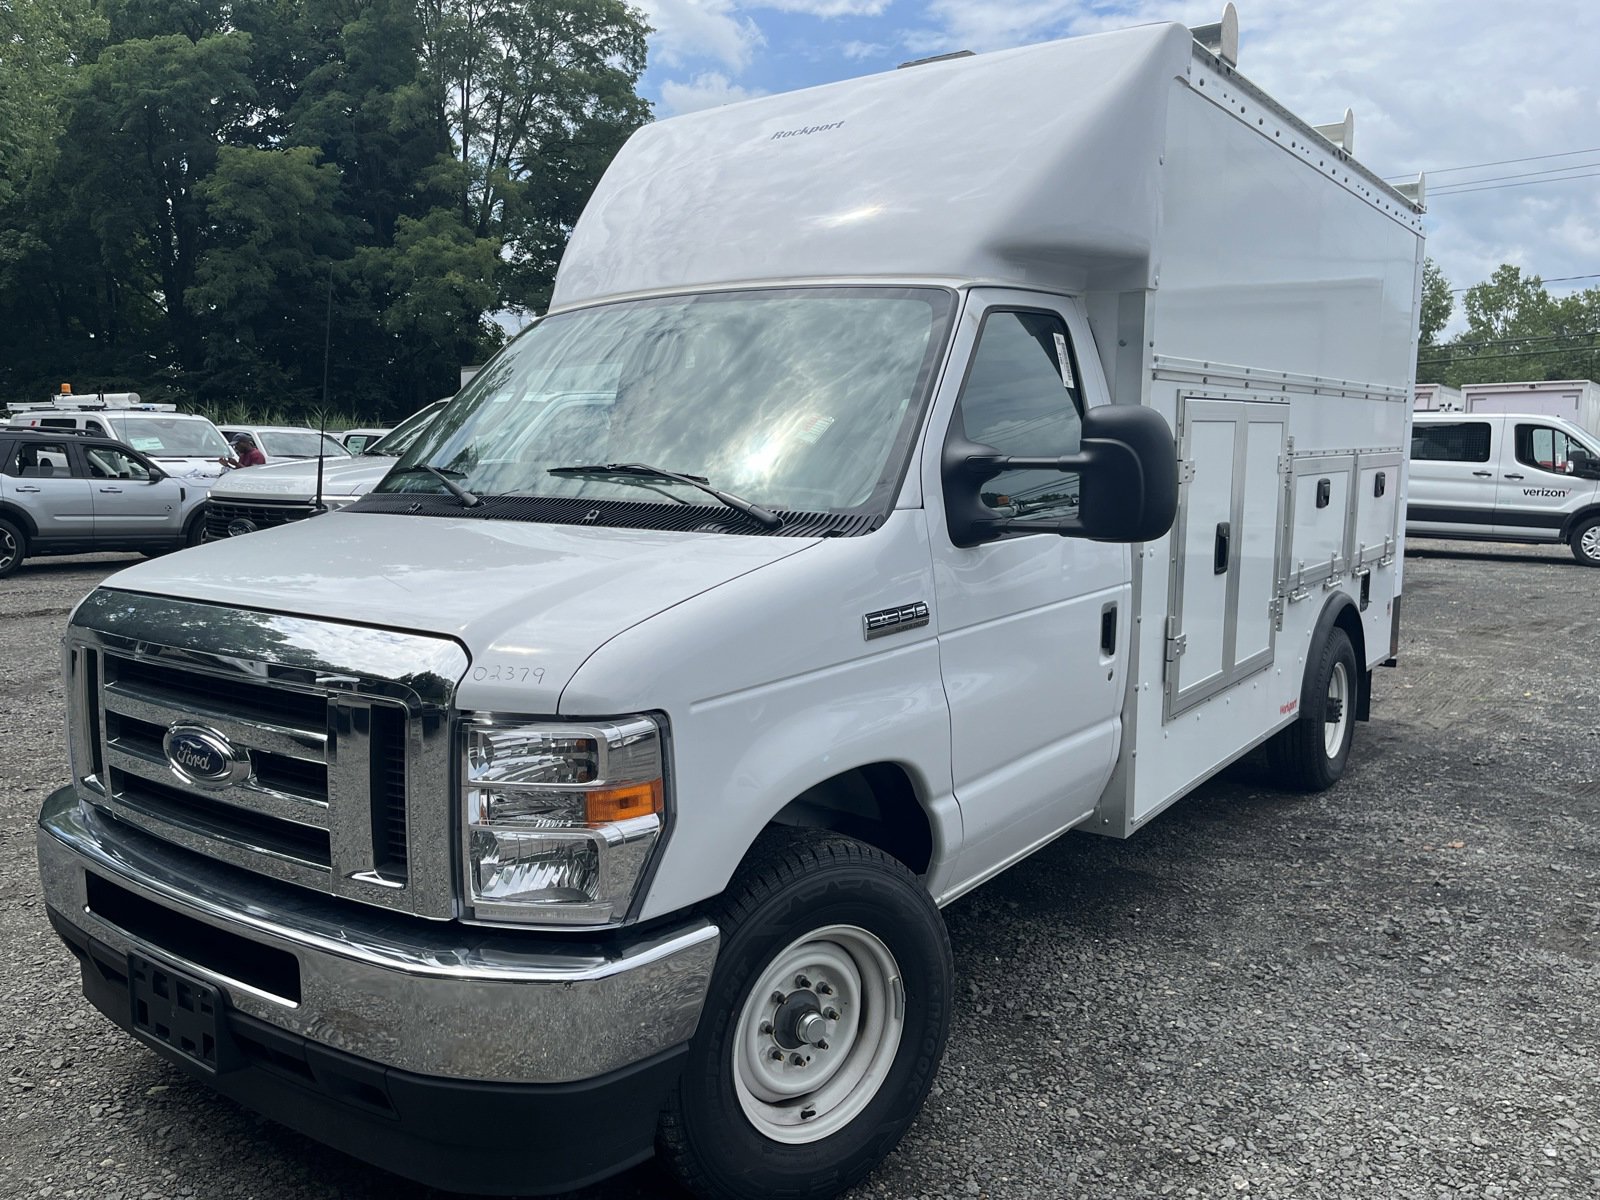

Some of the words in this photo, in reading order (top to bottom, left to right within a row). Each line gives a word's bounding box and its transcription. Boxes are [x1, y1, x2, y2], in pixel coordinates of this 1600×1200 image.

[770, 120, 845, 140] Rockport
[1523, 487, 1566, 498] verizon
[473, 664, 546, 685] 02379
[176, 739, 211, 770] Ford
